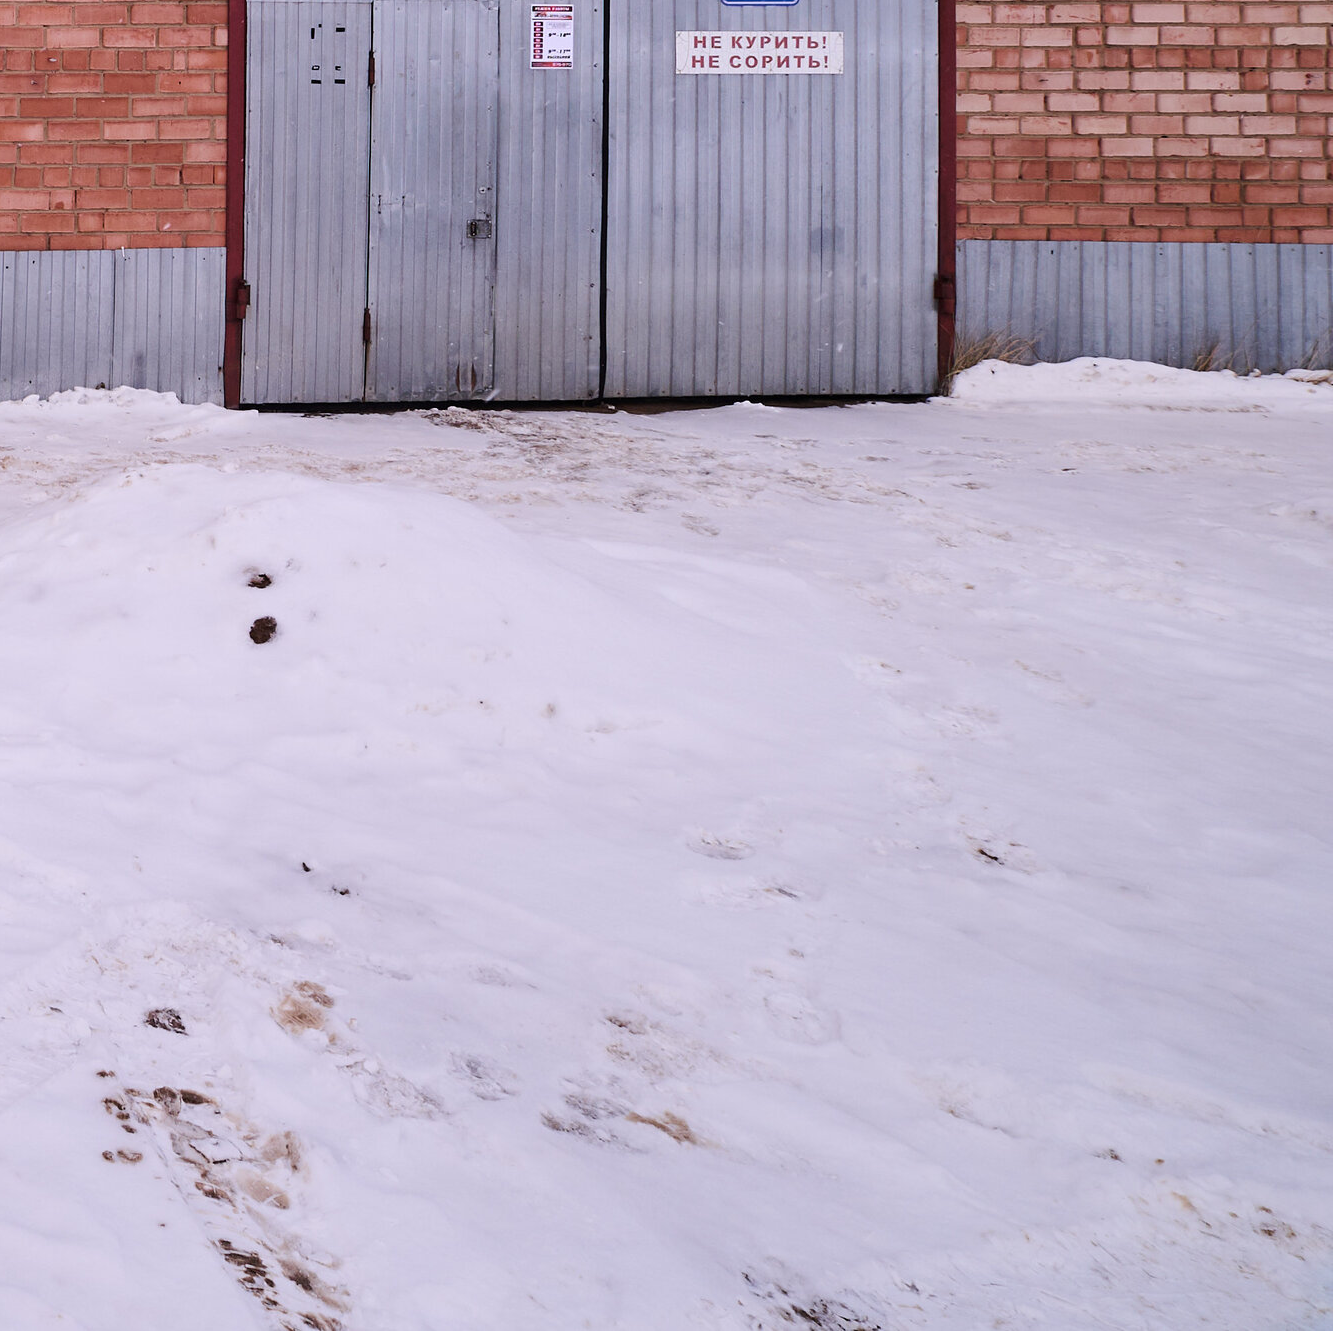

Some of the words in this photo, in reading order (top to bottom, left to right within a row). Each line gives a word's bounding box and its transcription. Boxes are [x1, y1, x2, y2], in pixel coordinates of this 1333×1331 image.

[693, 35, 722, 49] НЕ
[731, 35, 827, 49] КУРИТЬ!
[691, 55, 720, 69] НЕ
[729, 55, 828, 69] СОРИТЬ!
